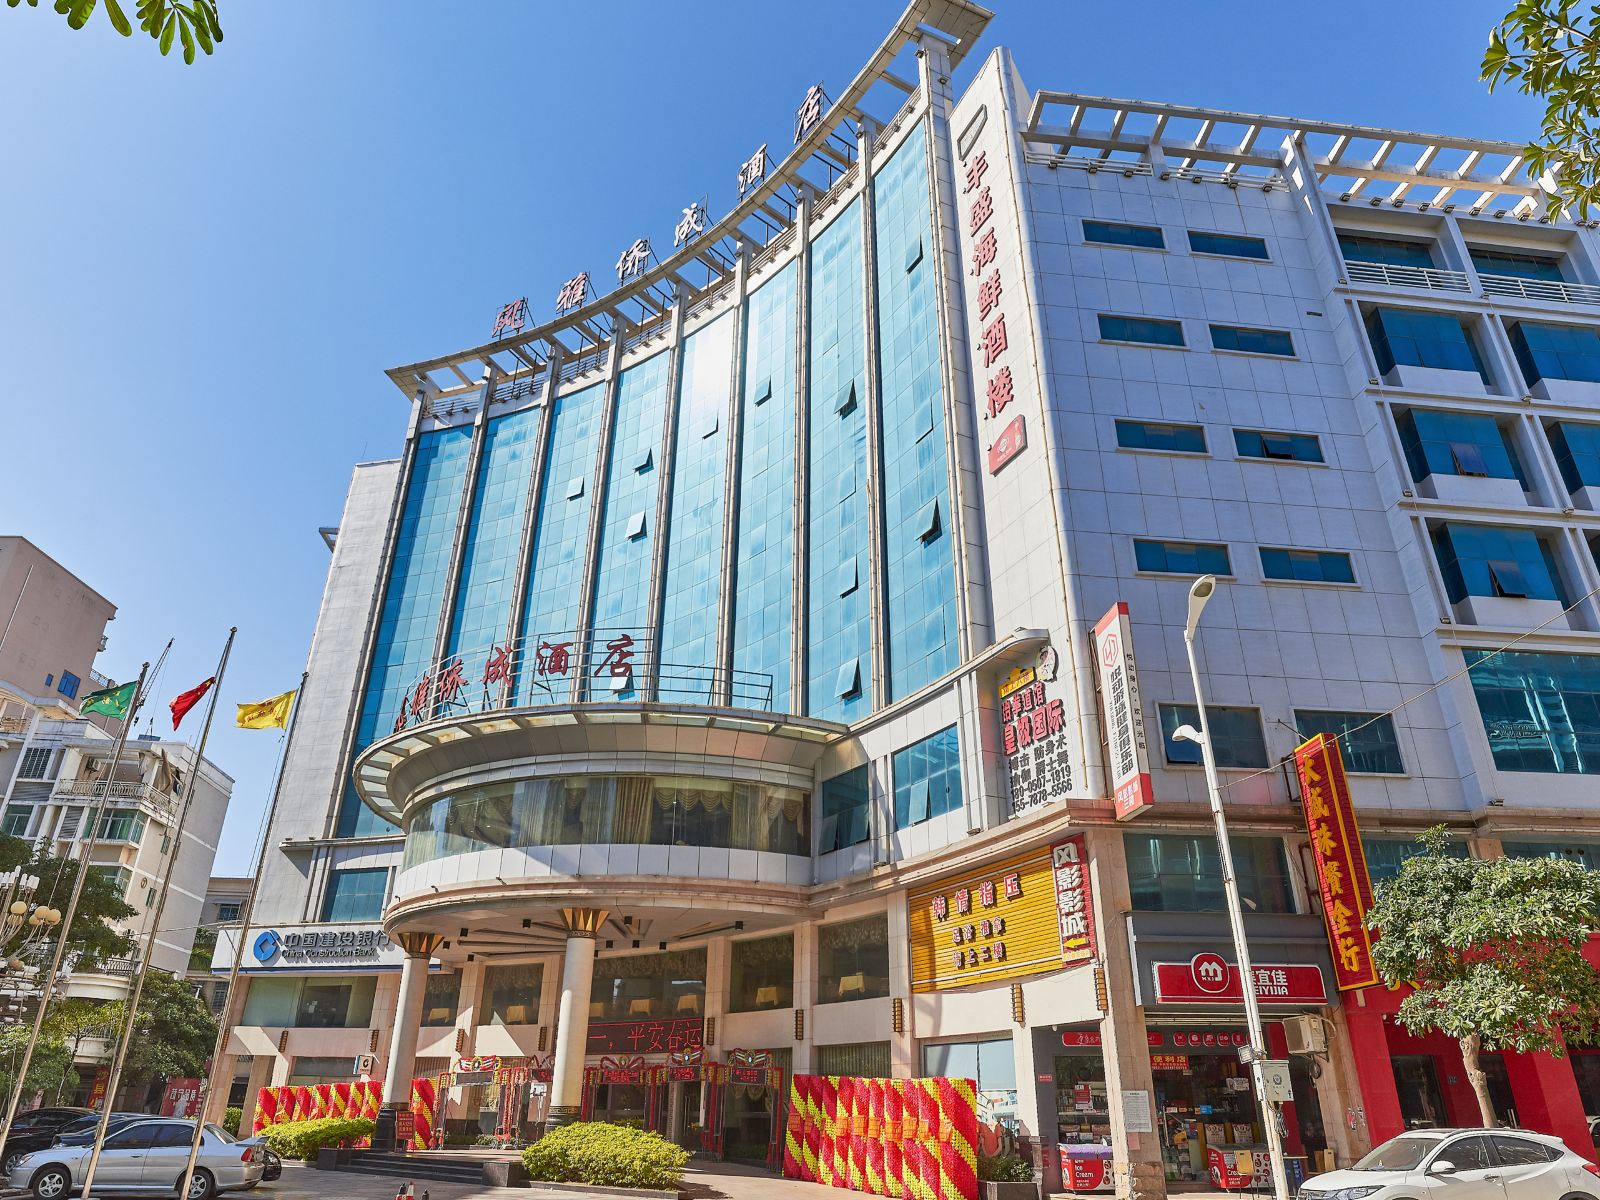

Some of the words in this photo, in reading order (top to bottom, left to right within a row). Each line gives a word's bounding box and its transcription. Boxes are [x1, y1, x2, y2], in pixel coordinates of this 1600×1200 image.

[964, 151, 1015, 418] 丰盛海鲜酒楼
[1034, 734, 1067, 761] 防身术
[932, 873, 1019, 918] 韩情指压
[284, 930, 390, 947] 中国建设银行
[282, 949, 304, 958] China
[305, 948, 352, 958] Construction
[354, 947, 376, 956] Bank
[1254, 986, 1288, 995] EIYIJIA
